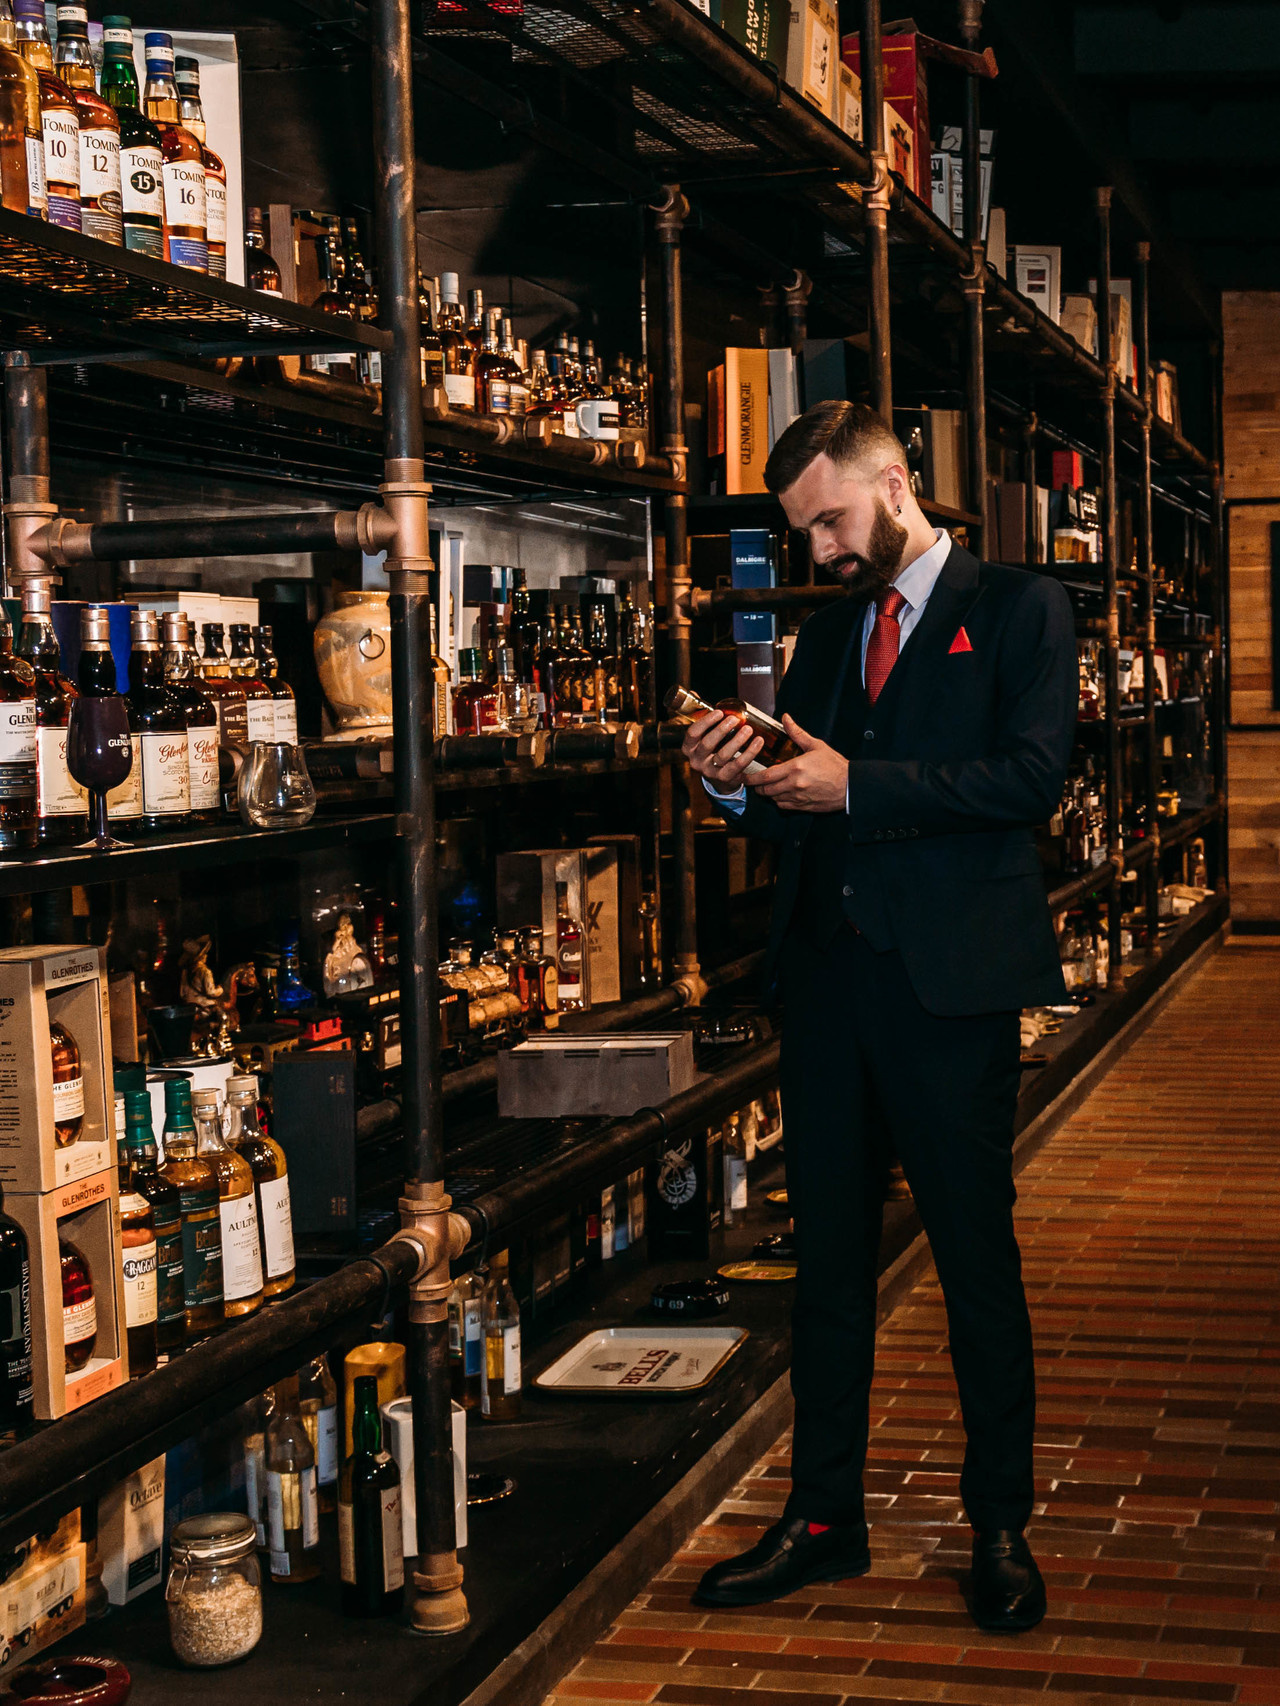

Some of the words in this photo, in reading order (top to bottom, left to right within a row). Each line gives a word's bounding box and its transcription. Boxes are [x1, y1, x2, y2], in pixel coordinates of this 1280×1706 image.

[50, 139, 67, 158] 10
[92, 154, 108, 173] 12
[137, 174, 151, 190] 15
[180, 187, 195, 205] 16
[741, 382, 751, 465] GLENMORANGIE
[51, 962, 94, 979] GLENROTHES
[62, 1184, 105, 1207] GLENROTHES
[137, 1281, 145, 1290] 12
[668, 1299, 684, 1310] 69
[618, 1350, 669, 1384] BELL'S
[130, 1482, 162, 1505] Octave
